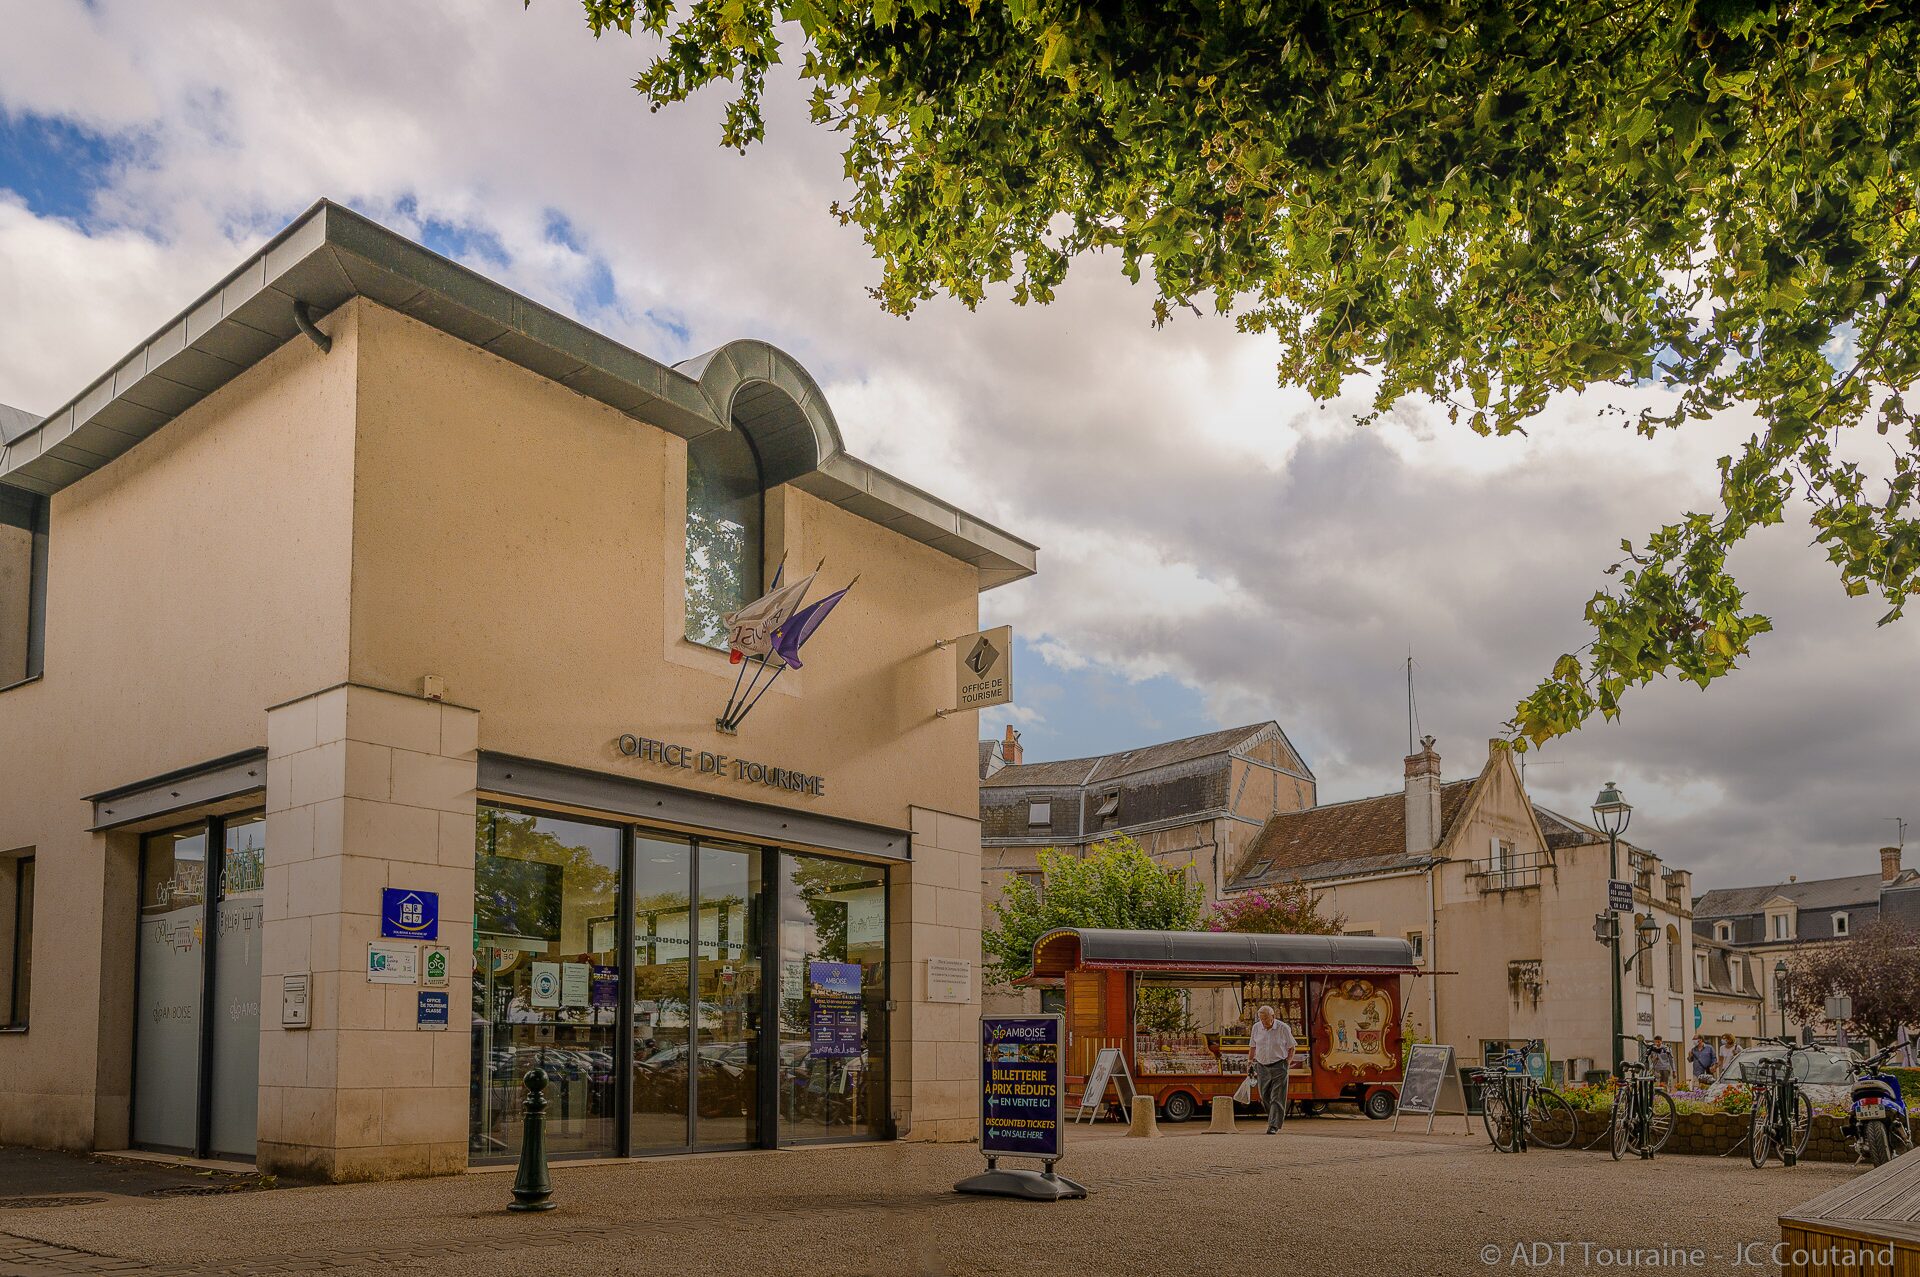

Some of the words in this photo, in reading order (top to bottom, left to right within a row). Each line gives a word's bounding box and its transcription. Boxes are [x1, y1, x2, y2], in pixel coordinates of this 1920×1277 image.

[962, 681, 989, 694] OFFICE
[991, 678, 1002, 688] DE
[962, 688, 1002, 703] TOURISME
[619, 733, 692, 768] OFFICE
[700, 751, 727, 776] DE
[736, 758, 825, 796] TOURISME
[1006, 1027, 1046, 1038] AMBOISE
[992, 1069, 1046, 1081] BILLETTERIE
[985, 1080, 991, 1094] À
[992, 1083, 1012, 1095] PRIX
[1014, 1081, 1056, 1096] RÉDUITS
[1000, 1097, 1011, 1107] EN
[1012, 1098, 1038, 1107] VENTE
[1039, 1098, 1050, 1108] ICI
[985, 1117, 1026, 1128] DISCOUNTED
[1027, 1119, 1055, 1129] TICKETS
[1001, 1129, 1011, 1137] ON
[1011, 1130, 1026, 1139] SALE
[1026, 1131, 1043, 1140] HERE
